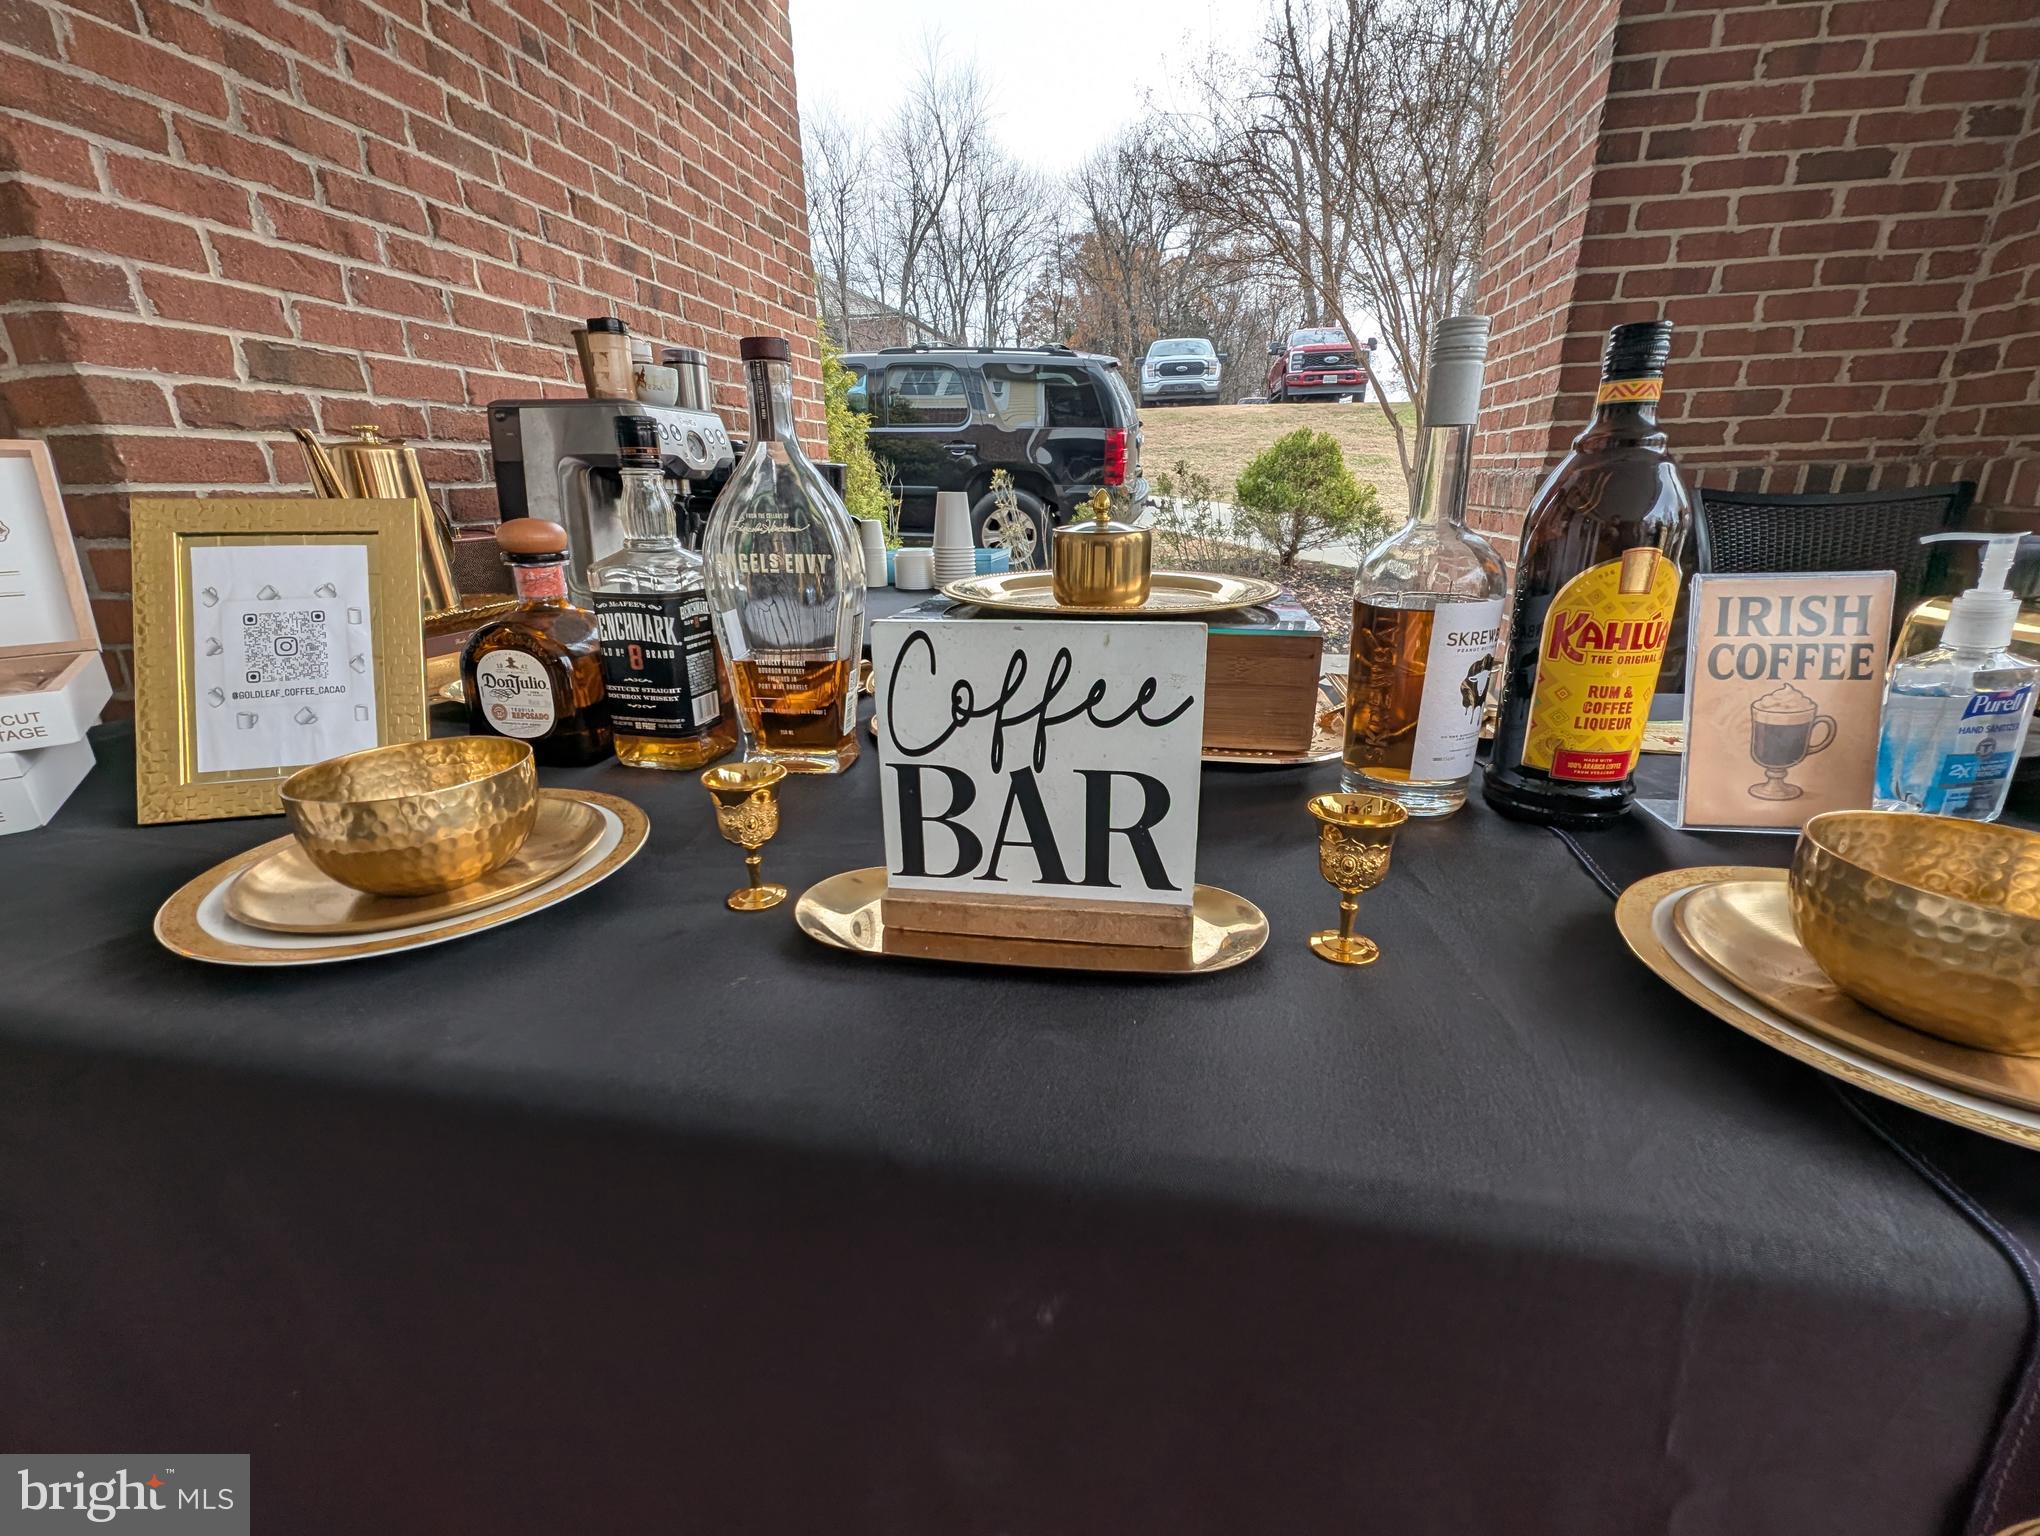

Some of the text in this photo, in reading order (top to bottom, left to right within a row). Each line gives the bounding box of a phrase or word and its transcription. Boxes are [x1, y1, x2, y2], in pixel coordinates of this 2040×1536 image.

[785, 553, 828, 574] ENVY
[1713, 594, 1873, 637] IRISH
[627, 643, 645, 671] 8
[645, 649, 675, 660] BRAND
[1591, 653, 1658, 665] THE ORIGINAL
[1707, 642, 1875, 681] COFFEE
[231, 685, 346, 700] @GOLDLEAF_COFFEE_CACAO
[1588, 685, 1634, 699] RUM &
[887, 630, 1195, 775] Coffee
[1582, 701, 1634, 714] COFFEE
[1972, 693, 2025, 714] Purell
[0, 711, 40, 727] CUT
[1574, 717, 1632, 730] LIQUEUR
[1958, 725, 1984, 735] HAND
[885, 763, 1182, 891] BAR
